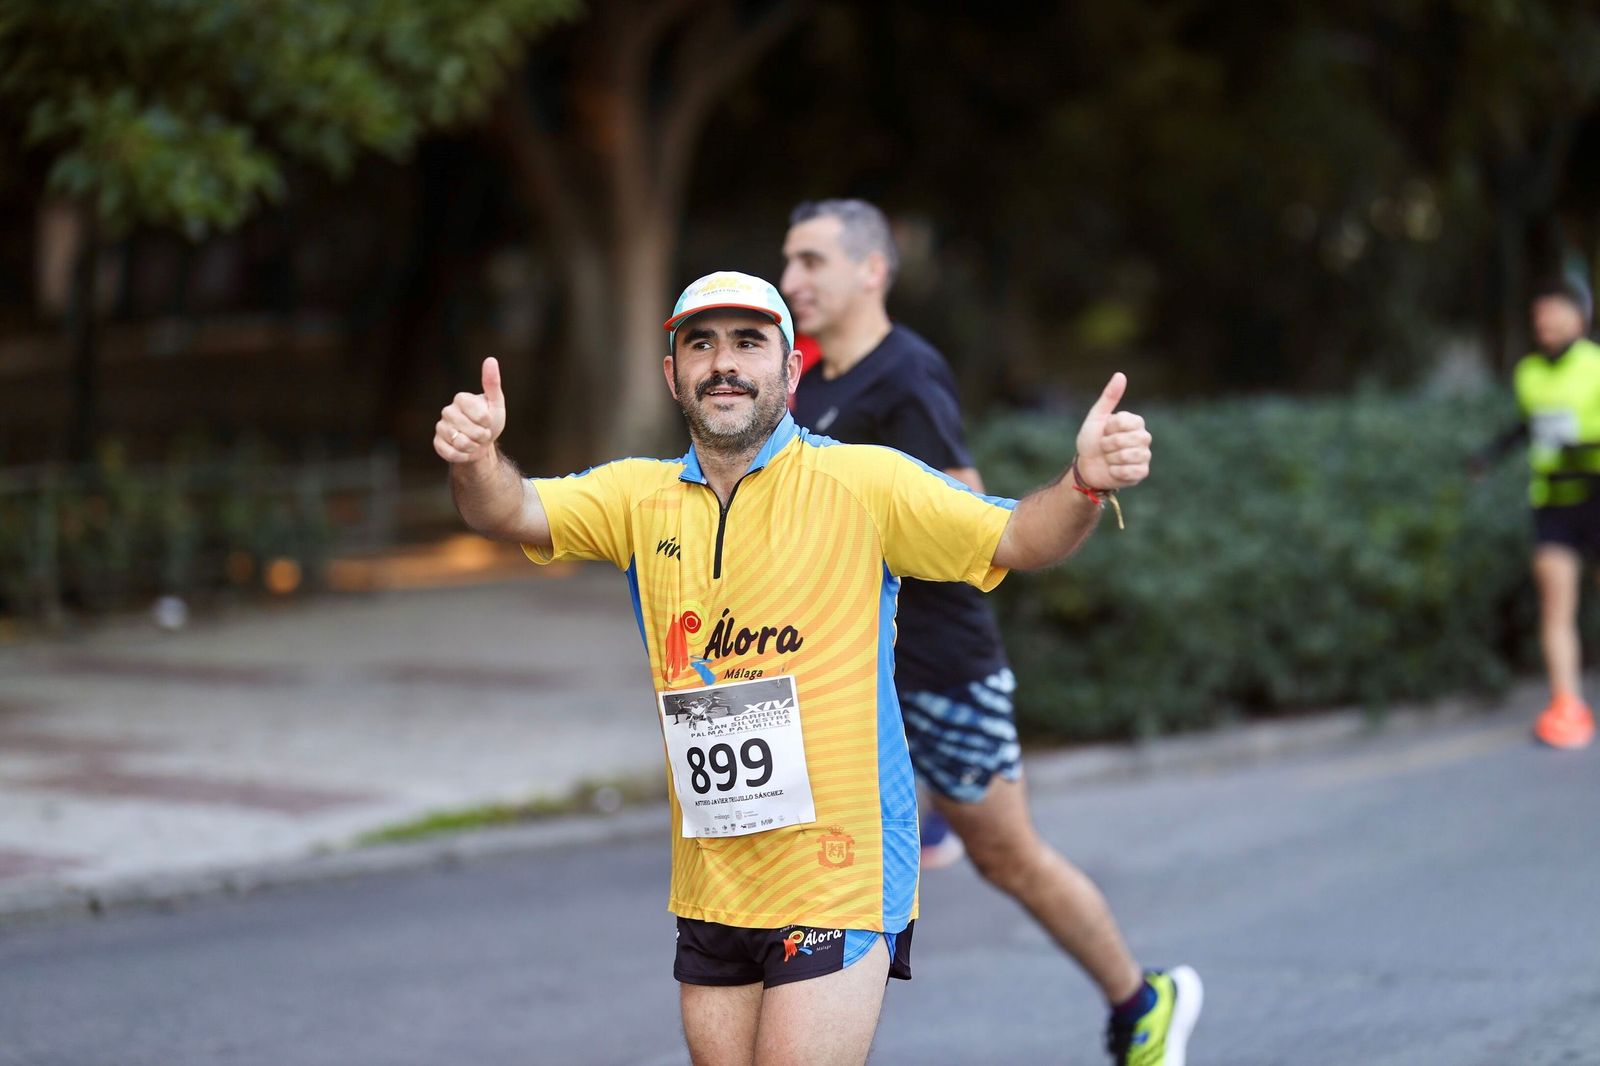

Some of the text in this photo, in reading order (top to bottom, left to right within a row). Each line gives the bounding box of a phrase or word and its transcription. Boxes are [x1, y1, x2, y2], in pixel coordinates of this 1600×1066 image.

[703, 608, 803, 660] Álora
[723, 668, 764, 681] Málaga
[741, 698, 793, 714] XIV
[708, 723, 728, 731] SAN
[731, 714, 791, 727] SILVESTRE
[734, 709, 791, 722] CARRERA
[690, 729, 724, 738] PALMA
[729, 719, 791, 733] PALMILLA
[686, 738, 773, 794] 899
[803, 929, 842, 947] Álora
